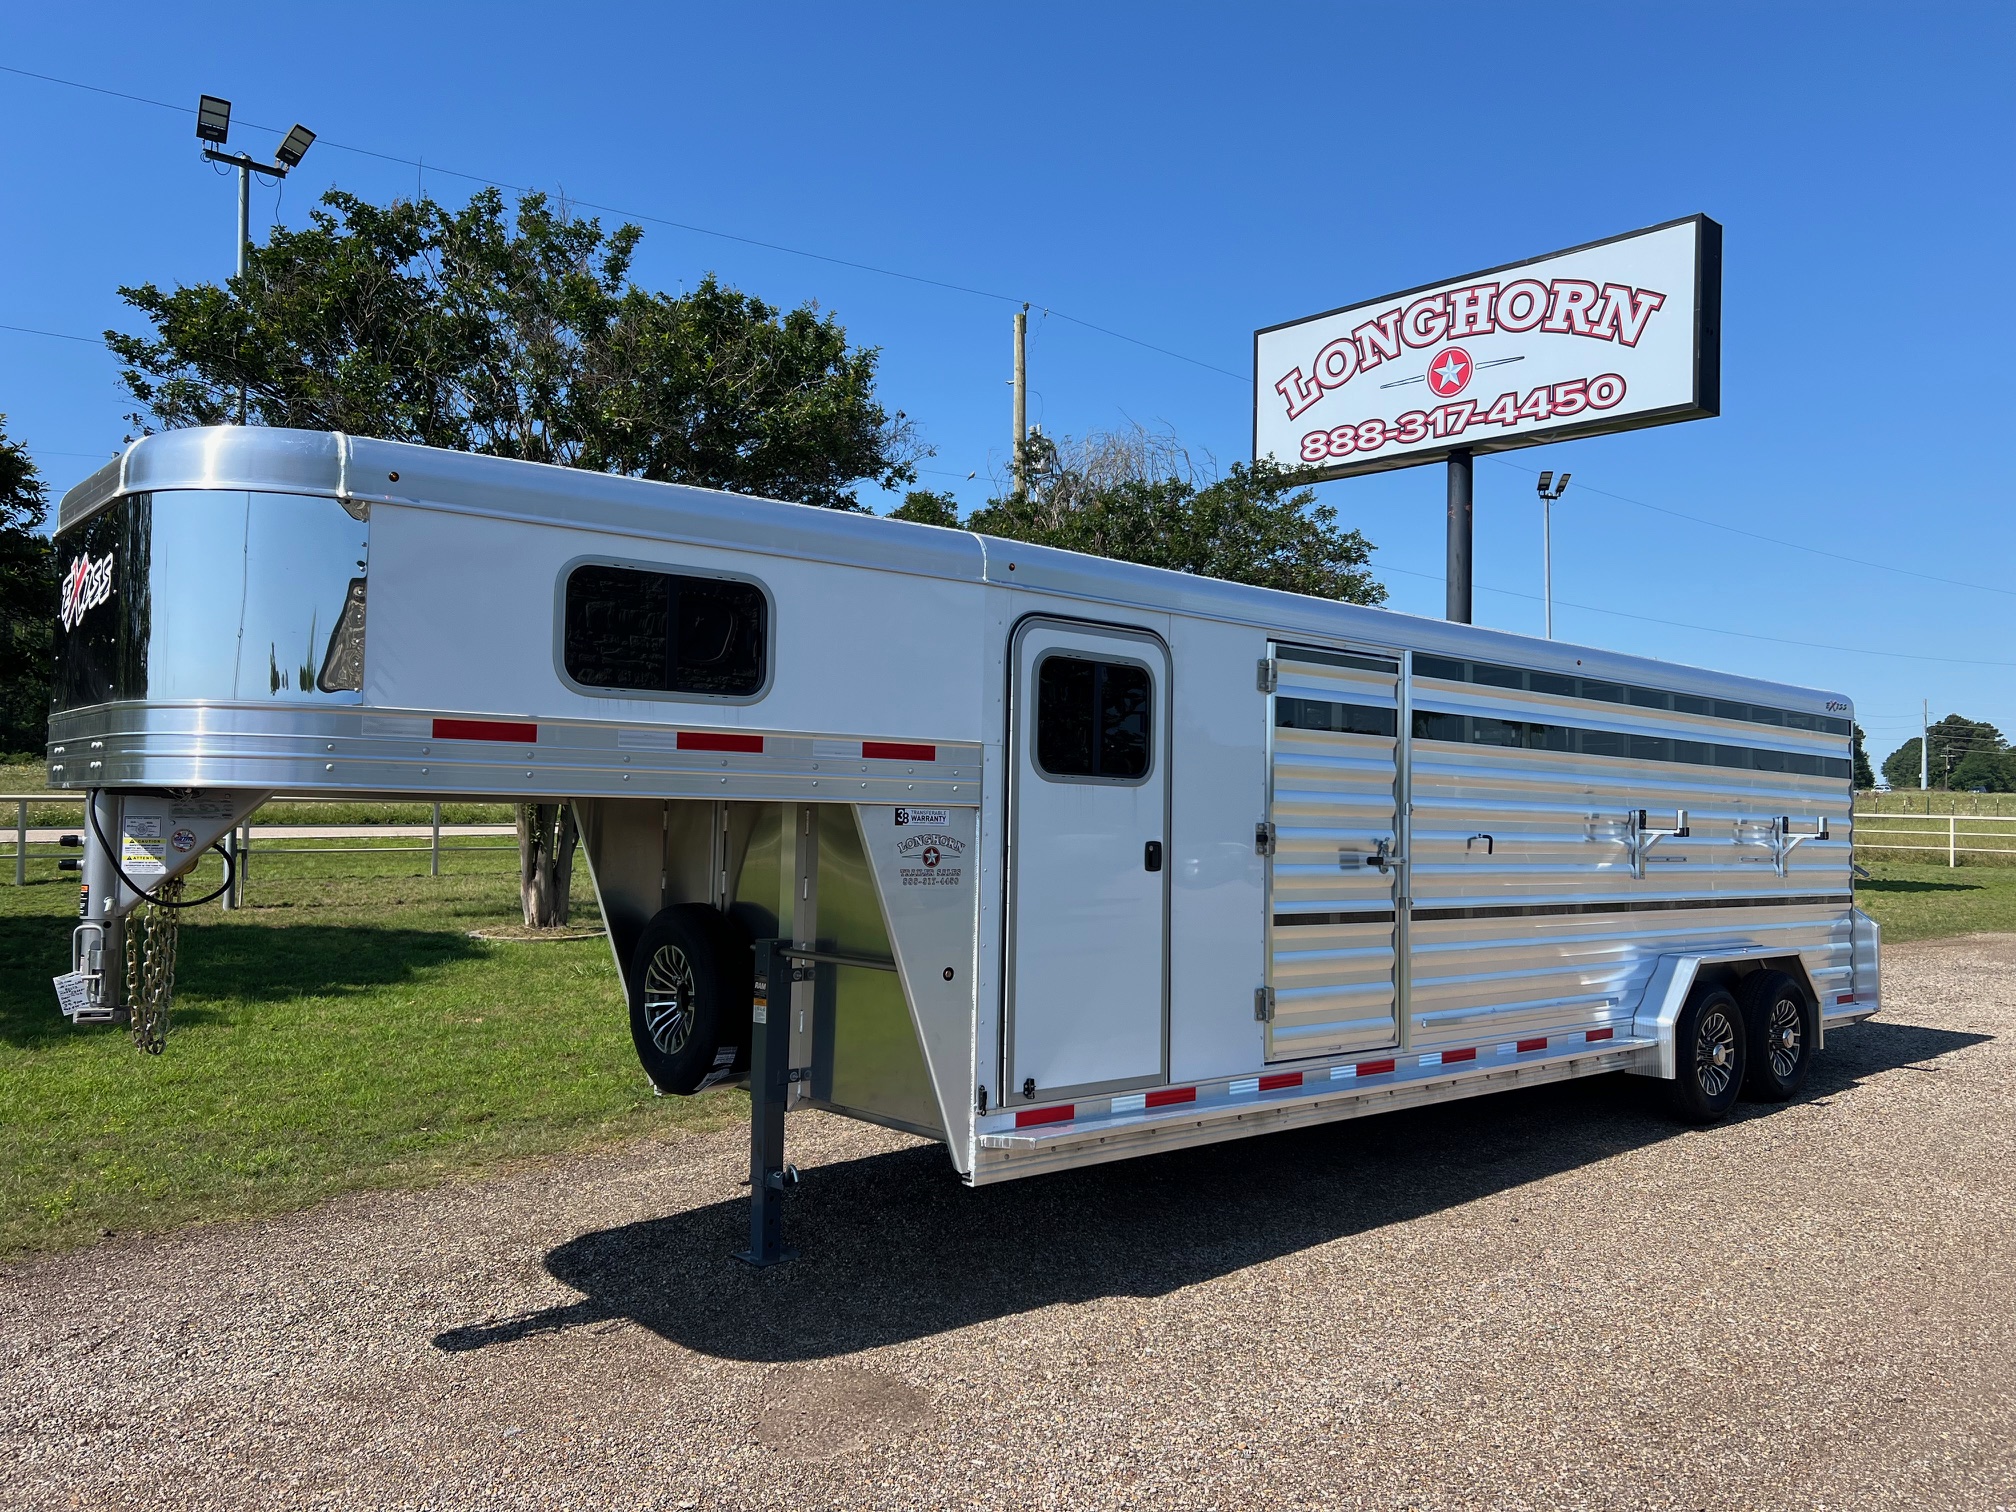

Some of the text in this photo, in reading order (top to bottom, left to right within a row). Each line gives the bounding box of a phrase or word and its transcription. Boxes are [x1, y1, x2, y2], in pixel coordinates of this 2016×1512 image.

[1275, 279, 1667, 421] LONGHORN
[1300, 373, 1627, 462] 888-317-4450
[897, 834, 966, 854] LONGHORN
[899, 868, 934, 877] TRAILER
[936, 868, 962, 877] SALES
[754, 981, 766, 990] RAM
